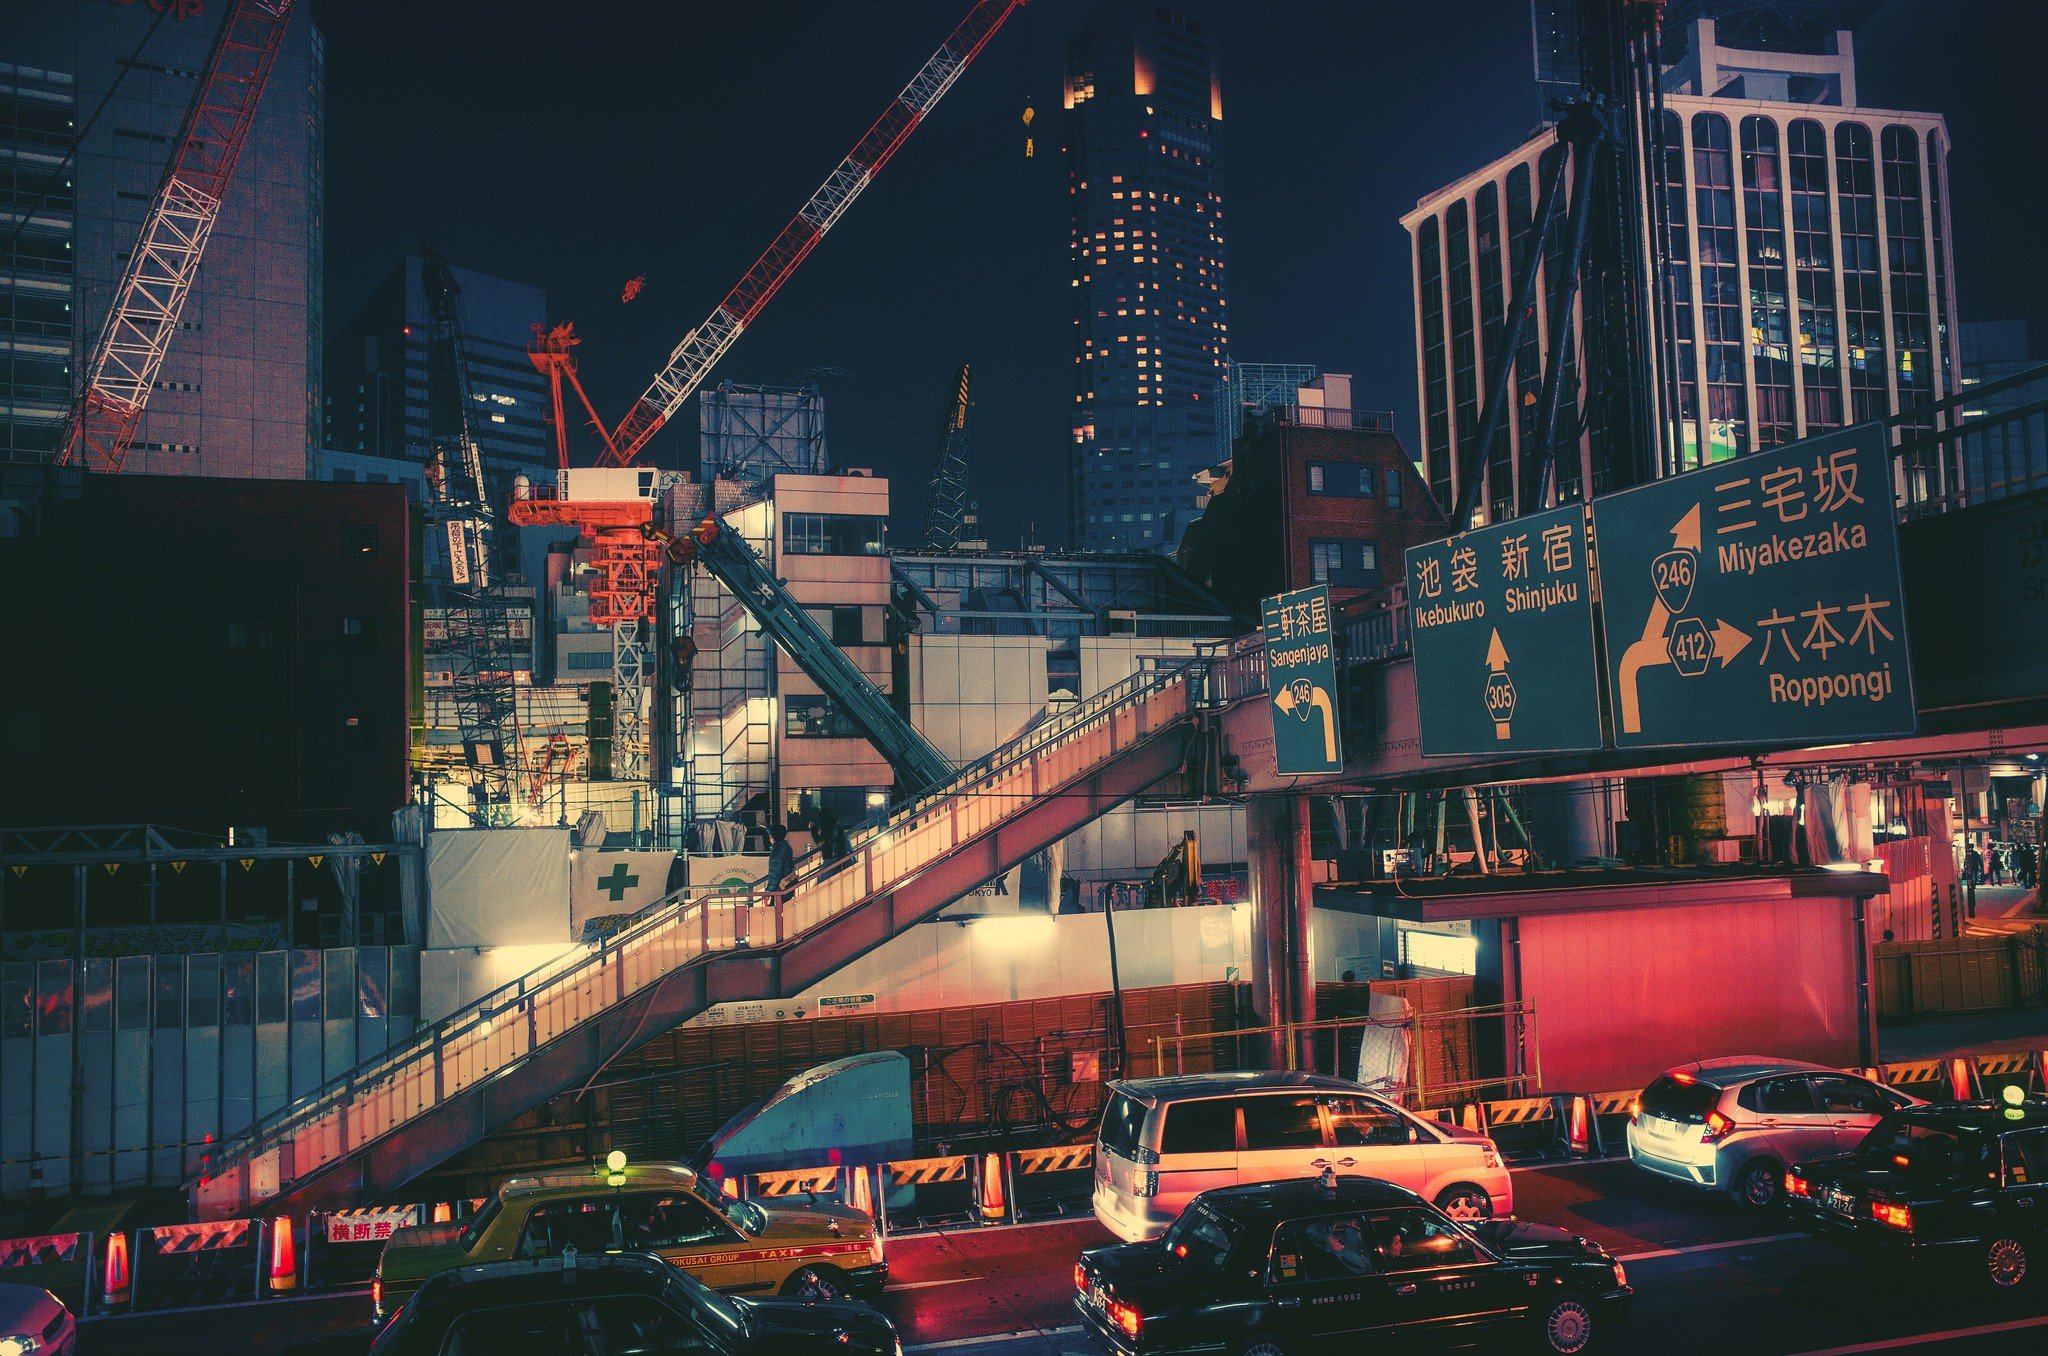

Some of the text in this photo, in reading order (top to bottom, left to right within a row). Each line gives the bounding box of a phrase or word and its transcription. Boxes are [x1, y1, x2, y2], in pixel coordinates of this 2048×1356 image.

[1714, 447, 1865, 534] 三宅坂
[1416, 524, 1573, 600] 池袋 新宿
[1717, 521, 1868, 576] Miyakezaka
[1657, 557, 1691, 591] 246
[1265, 596, 1328, 642] 三軒茶屋
[1415, 579, 1578, 629] Ikebukuro Shinjuku
[1676, 631, 1707, 662] 412
[1757, 593, 1894, 666] 六本木
[1270, 643, 1329, 668] Sangenjaya
[1293, 683, 1310, 704] 246
[1488, 684, 1512, 709] 305
[1769, 662, 1893, 707] Roppongi
[709, 1253, 740, 1263] GROUP
[759, 1249, 795, 1259] TAXI
[1337, 1292, 1361, 1302] 6982
